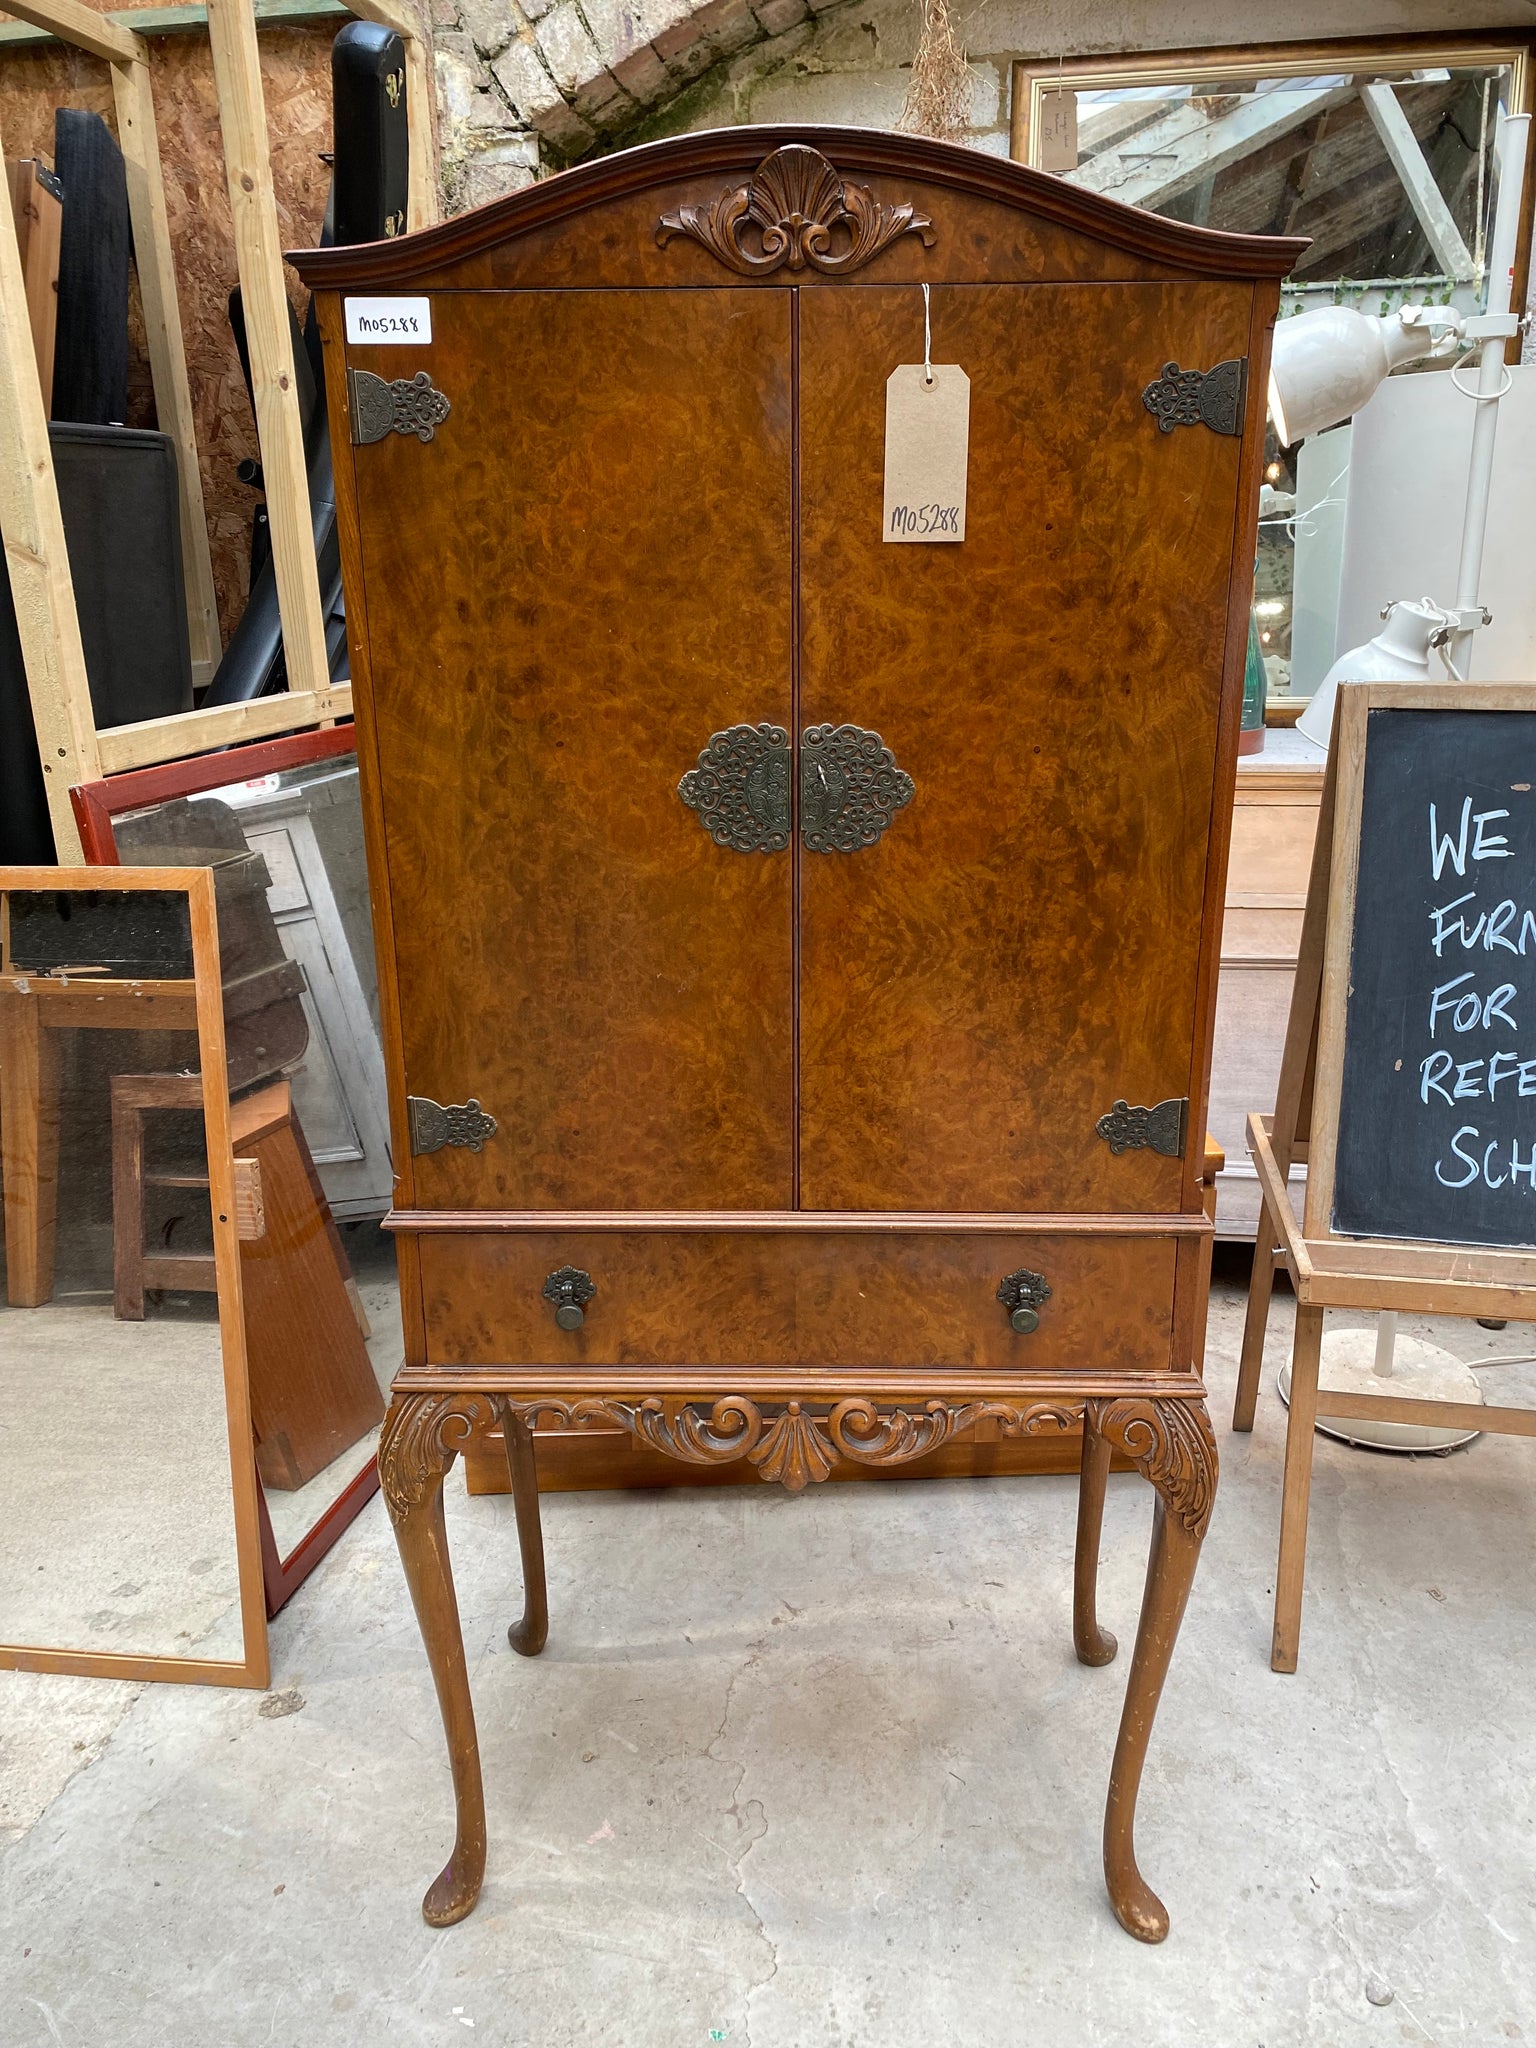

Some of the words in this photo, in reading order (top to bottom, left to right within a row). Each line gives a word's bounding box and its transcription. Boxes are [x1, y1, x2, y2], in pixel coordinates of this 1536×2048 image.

[1429, 796, 1516, 881] WE
[1429, 971, 1518, 1039] FOR
[1419, 1049, 1536, 1106] REFE
[1434, 1125, 1536, 1191] SCH
